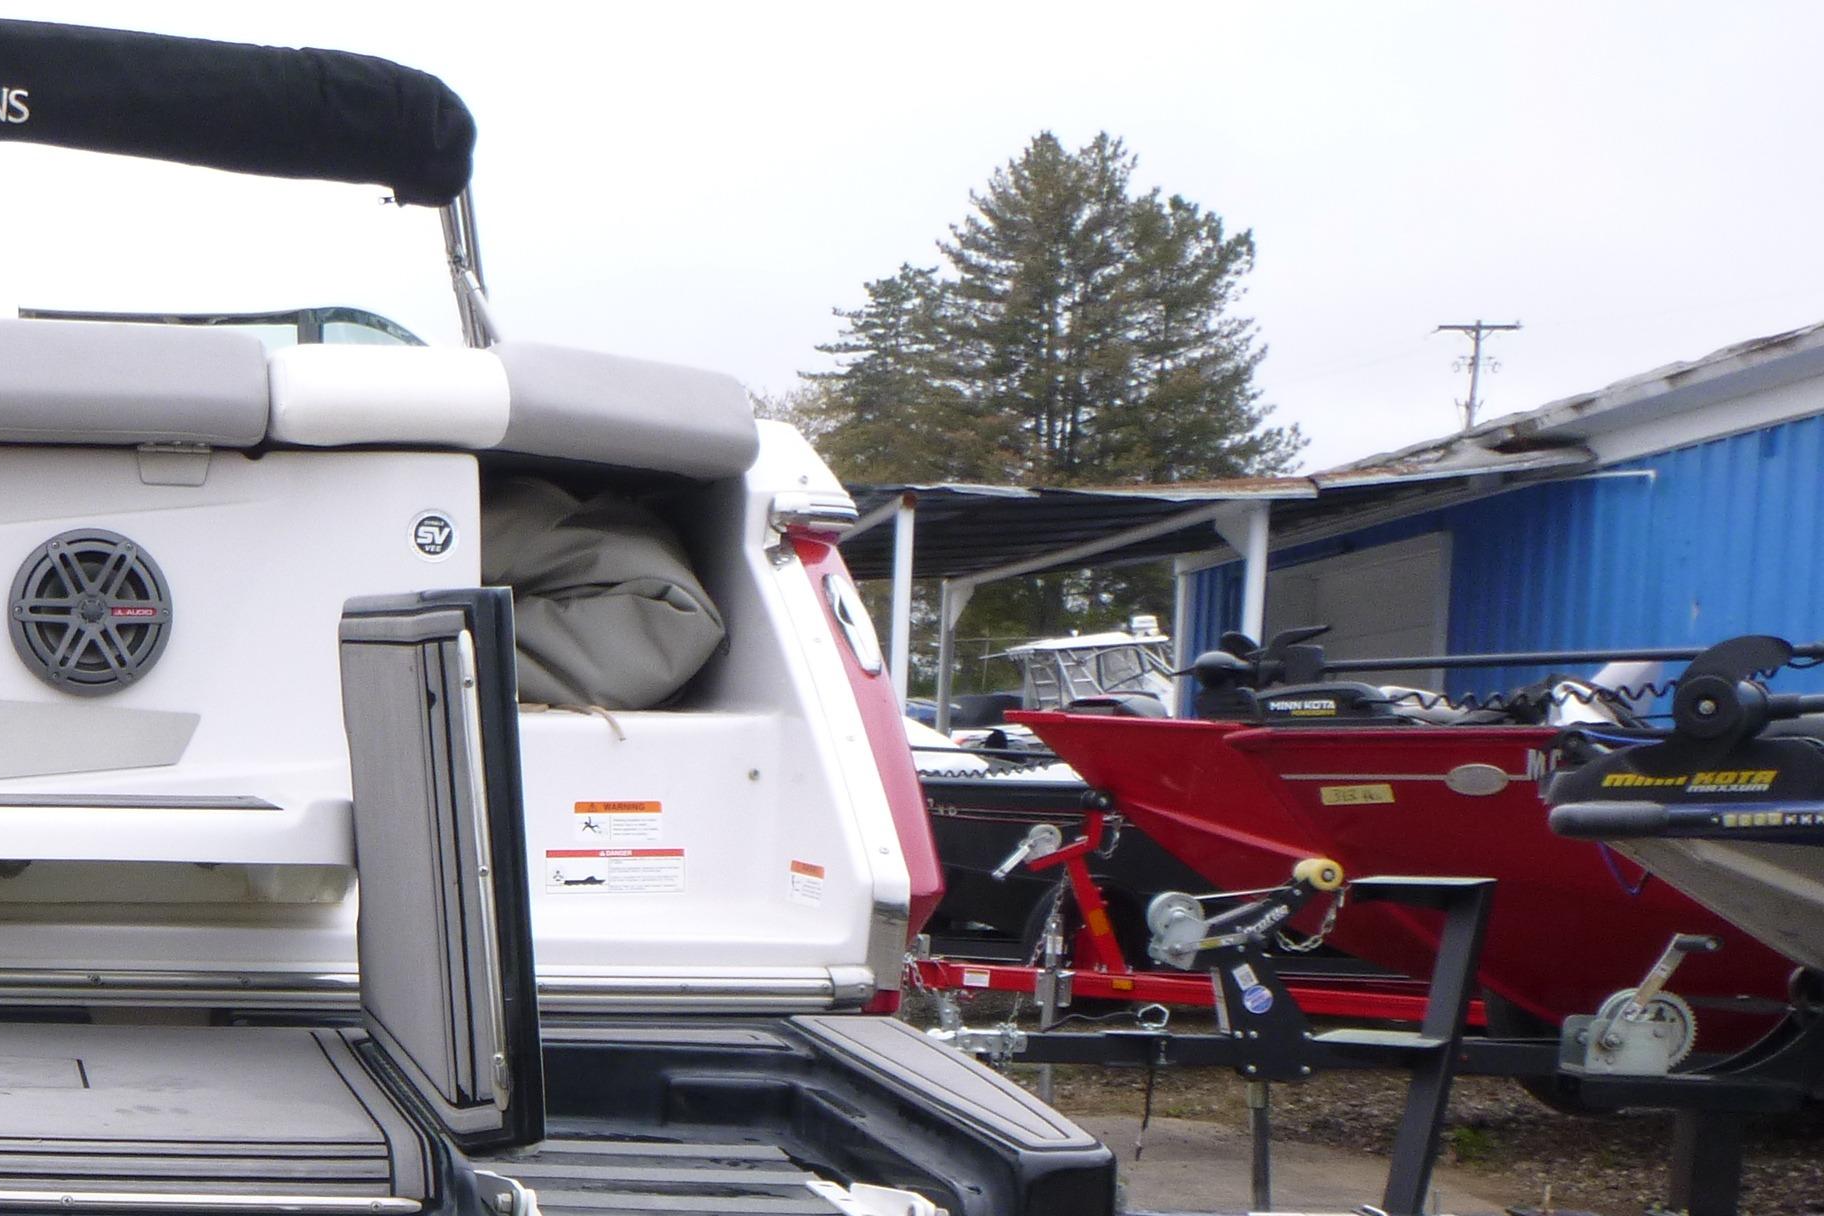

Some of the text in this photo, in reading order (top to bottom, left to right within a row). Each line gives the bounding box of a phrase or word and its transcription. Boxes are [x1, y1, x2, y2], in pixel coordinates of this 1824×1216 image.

[416, 526, 451, 544] SV
[1269, 700, 1336, 710] MINN KOTA
[1691, 770, 1778, 785] KOTA
[603, 803, 646, 811] WARNING
